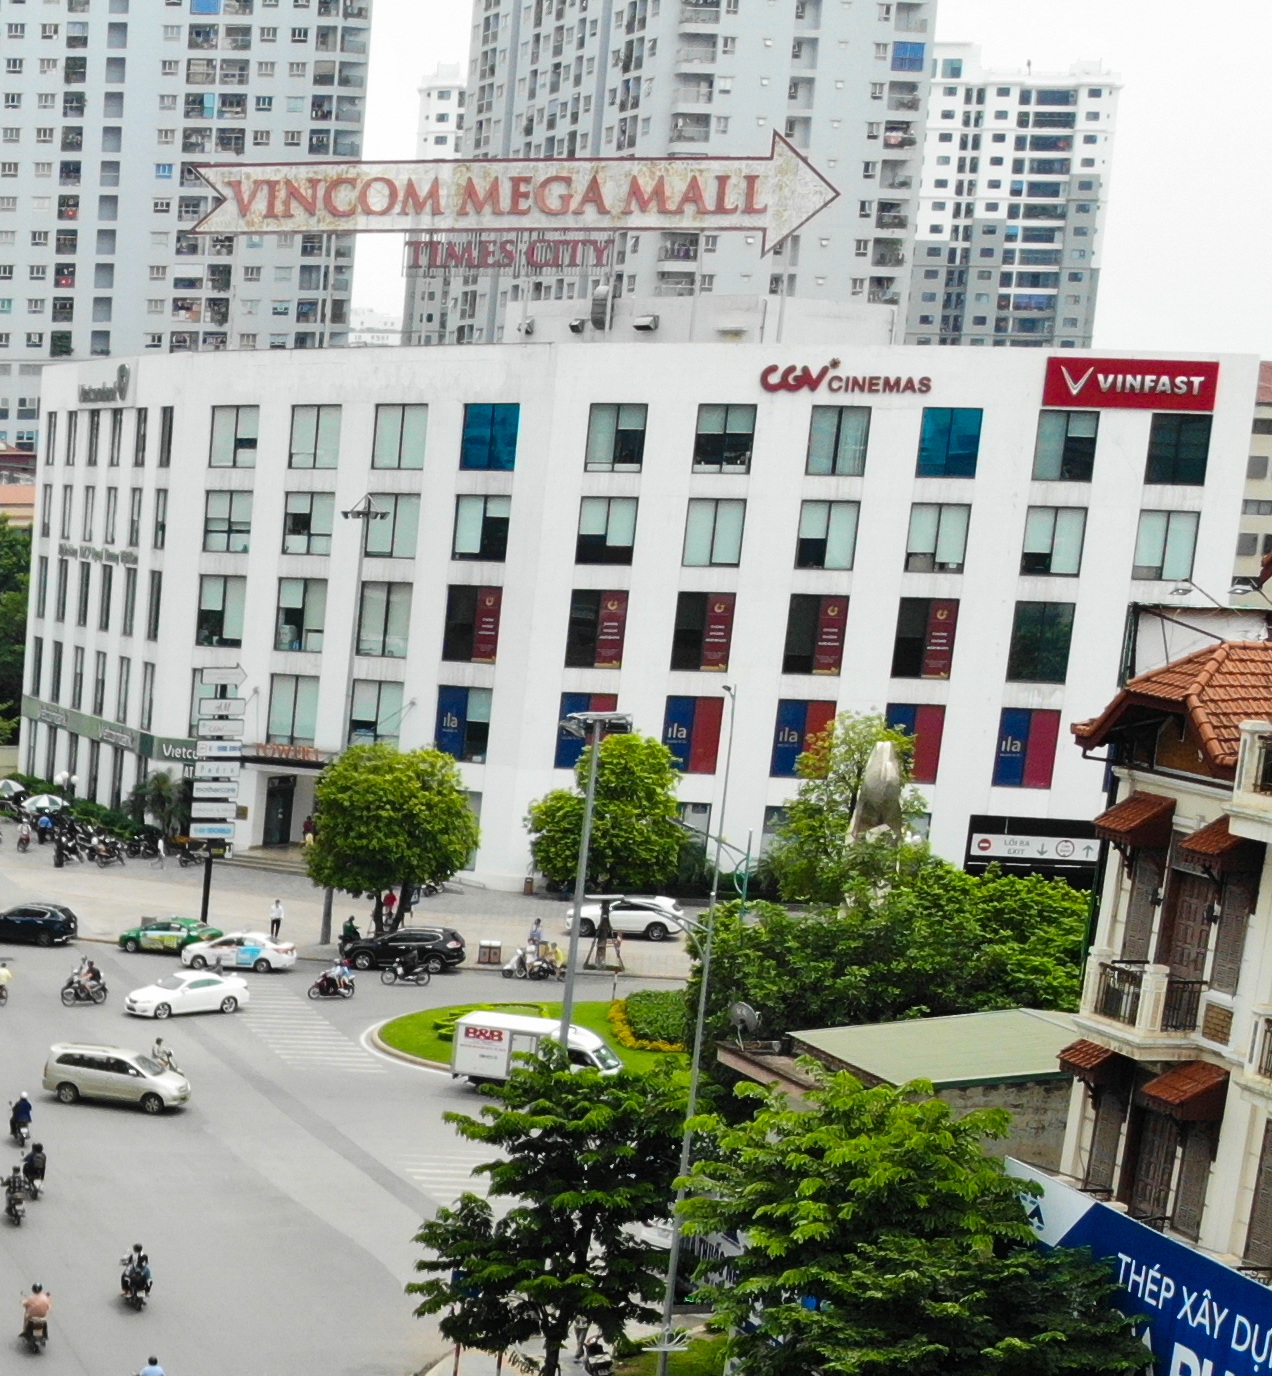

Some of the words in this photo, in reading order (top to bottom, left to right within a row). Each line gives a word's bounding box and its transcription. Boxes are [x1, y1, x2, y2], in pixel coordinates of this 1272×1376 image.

[224, 176, 445, 218] VINCOM
[456, 175, 610, 215] MEGA
[622, 174, 768, 215] MALL
[406, 239, 515, 268] TIMES
[525, 238, 614, 267] CITY
[760, 364, 830, 392] CGV
[828, 375, 932, 394] CINEMAS
[1097, 373, 1205, 396] VINFAST
[443, 712, 458, 727] ila
[668, 722, 687, 738] ila
[779, 727, 799, 742] ila
[1001, 736, 1022, 752] ila
[464, 1026, 504, 1042] B&B
[1117, 1252, 1175, 1309] THÉP
[1176, 1288, 1229, 1340] XÂY
[1230, 1313, 1272, 1373] DỰ
